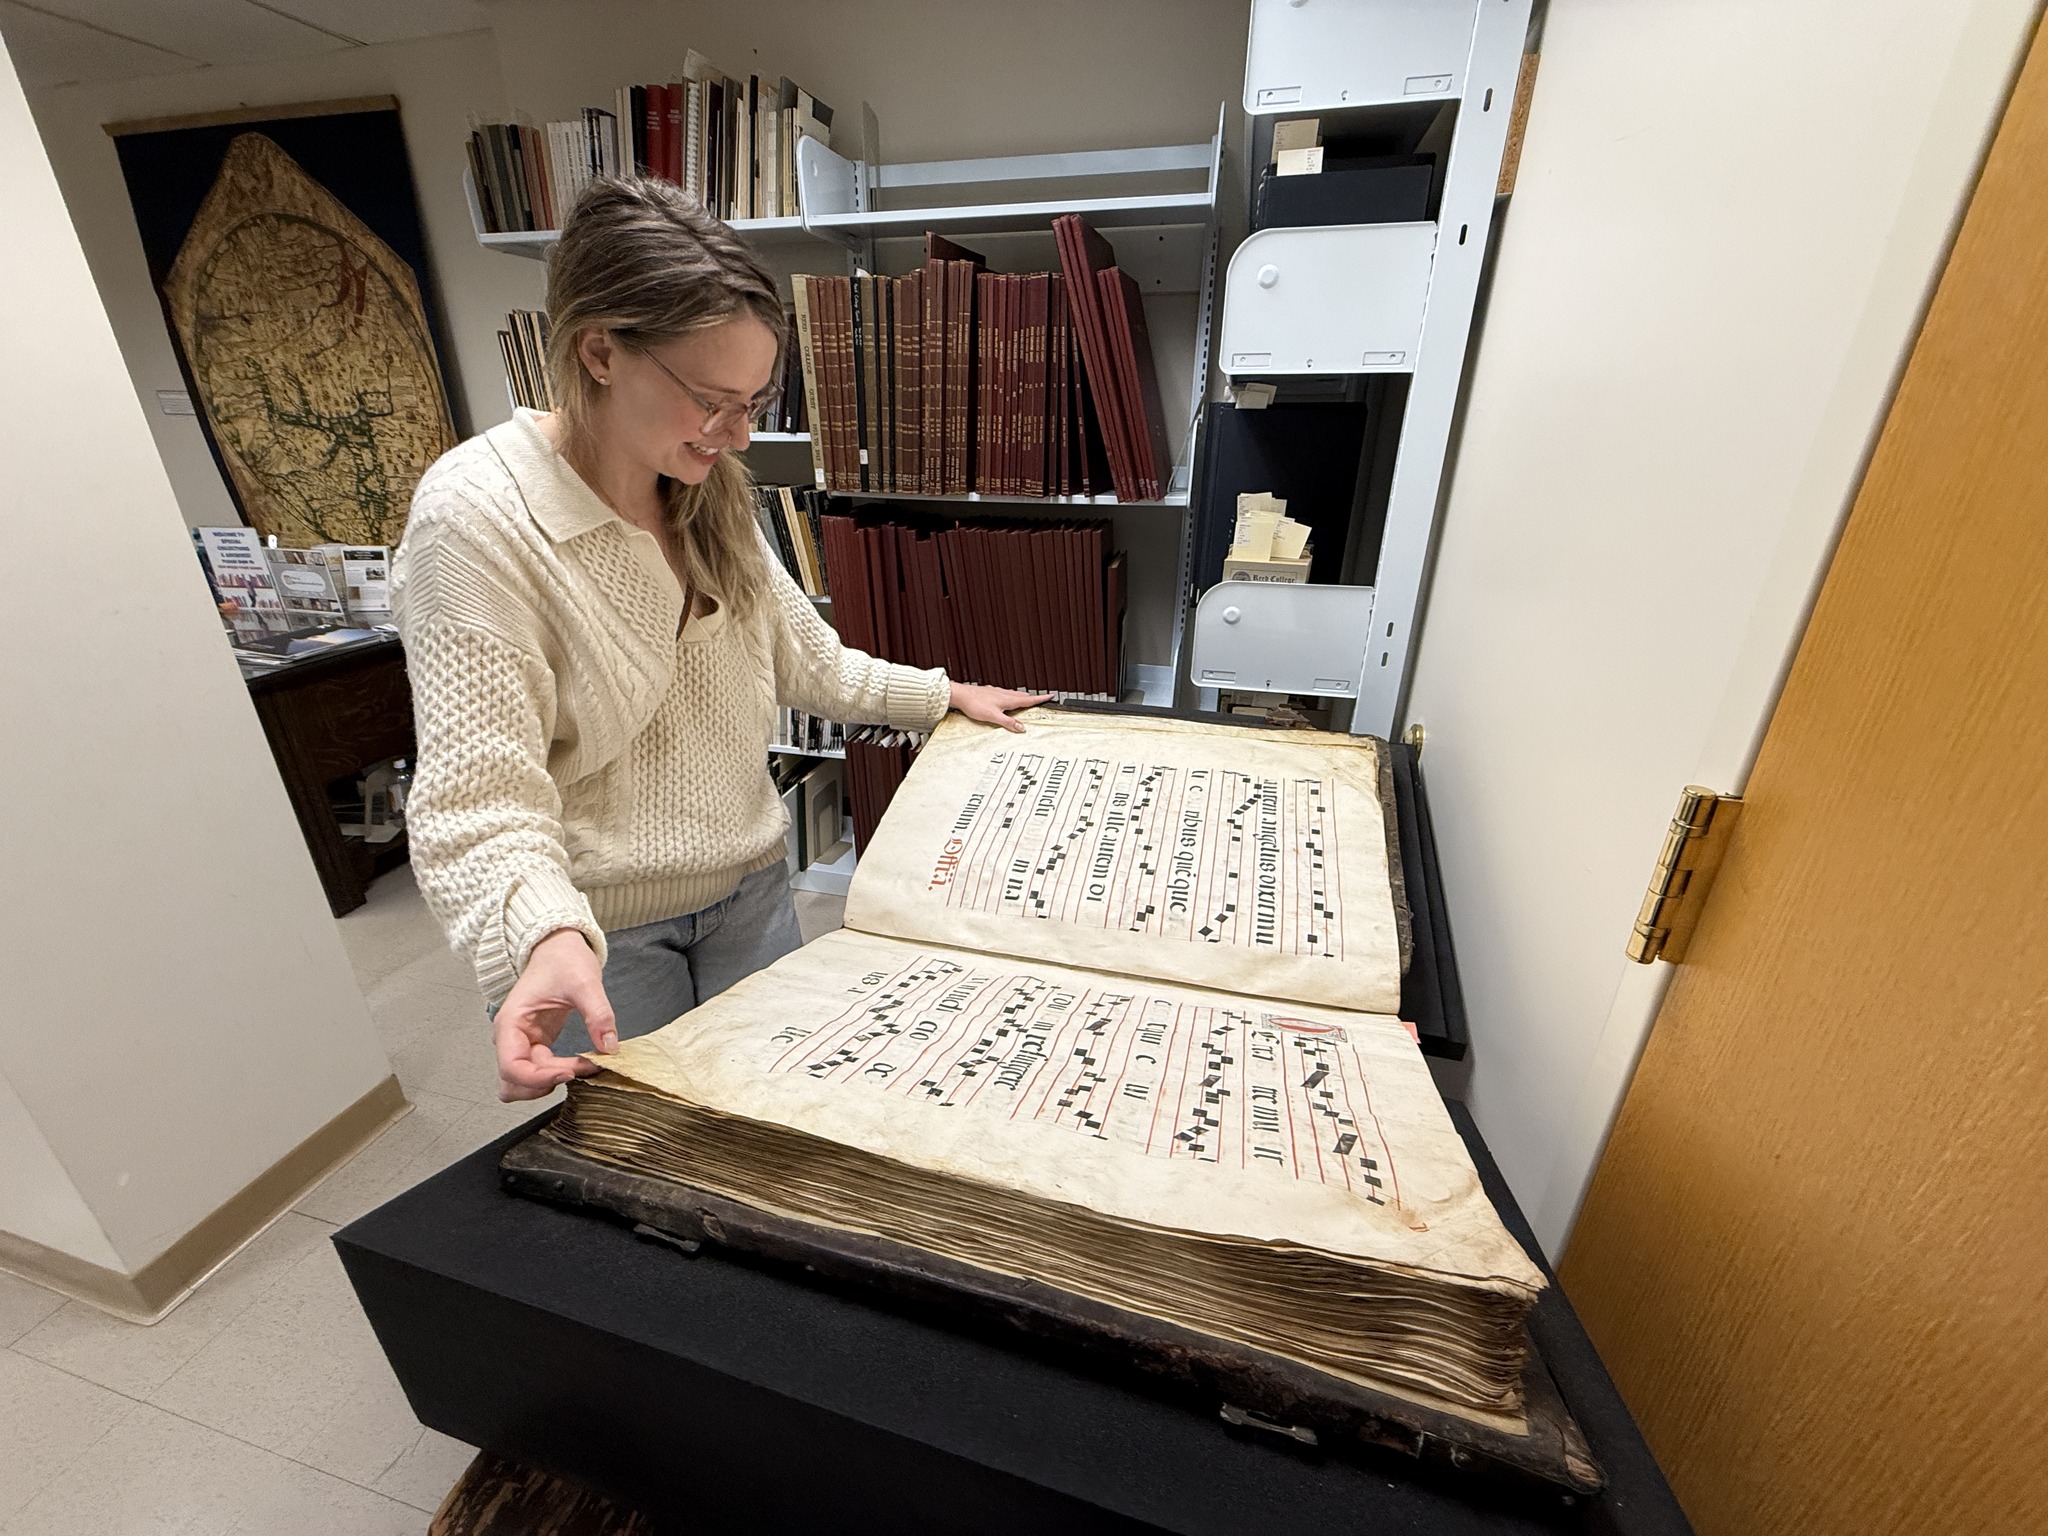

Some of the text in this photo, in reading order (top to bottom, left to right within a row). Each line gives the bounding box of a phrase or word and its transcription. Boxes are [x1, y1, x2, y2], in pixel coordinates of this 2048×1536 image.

[804, 345, 812, 375] COLLEGE
[813, 437, 819, 446] TO
[1270, 575, 1295, 583] College
[1260, 778, 1278, 816] autem
[1090, 833, 1117, 879] autem
[1251, 815, 1280, 873] angelus
